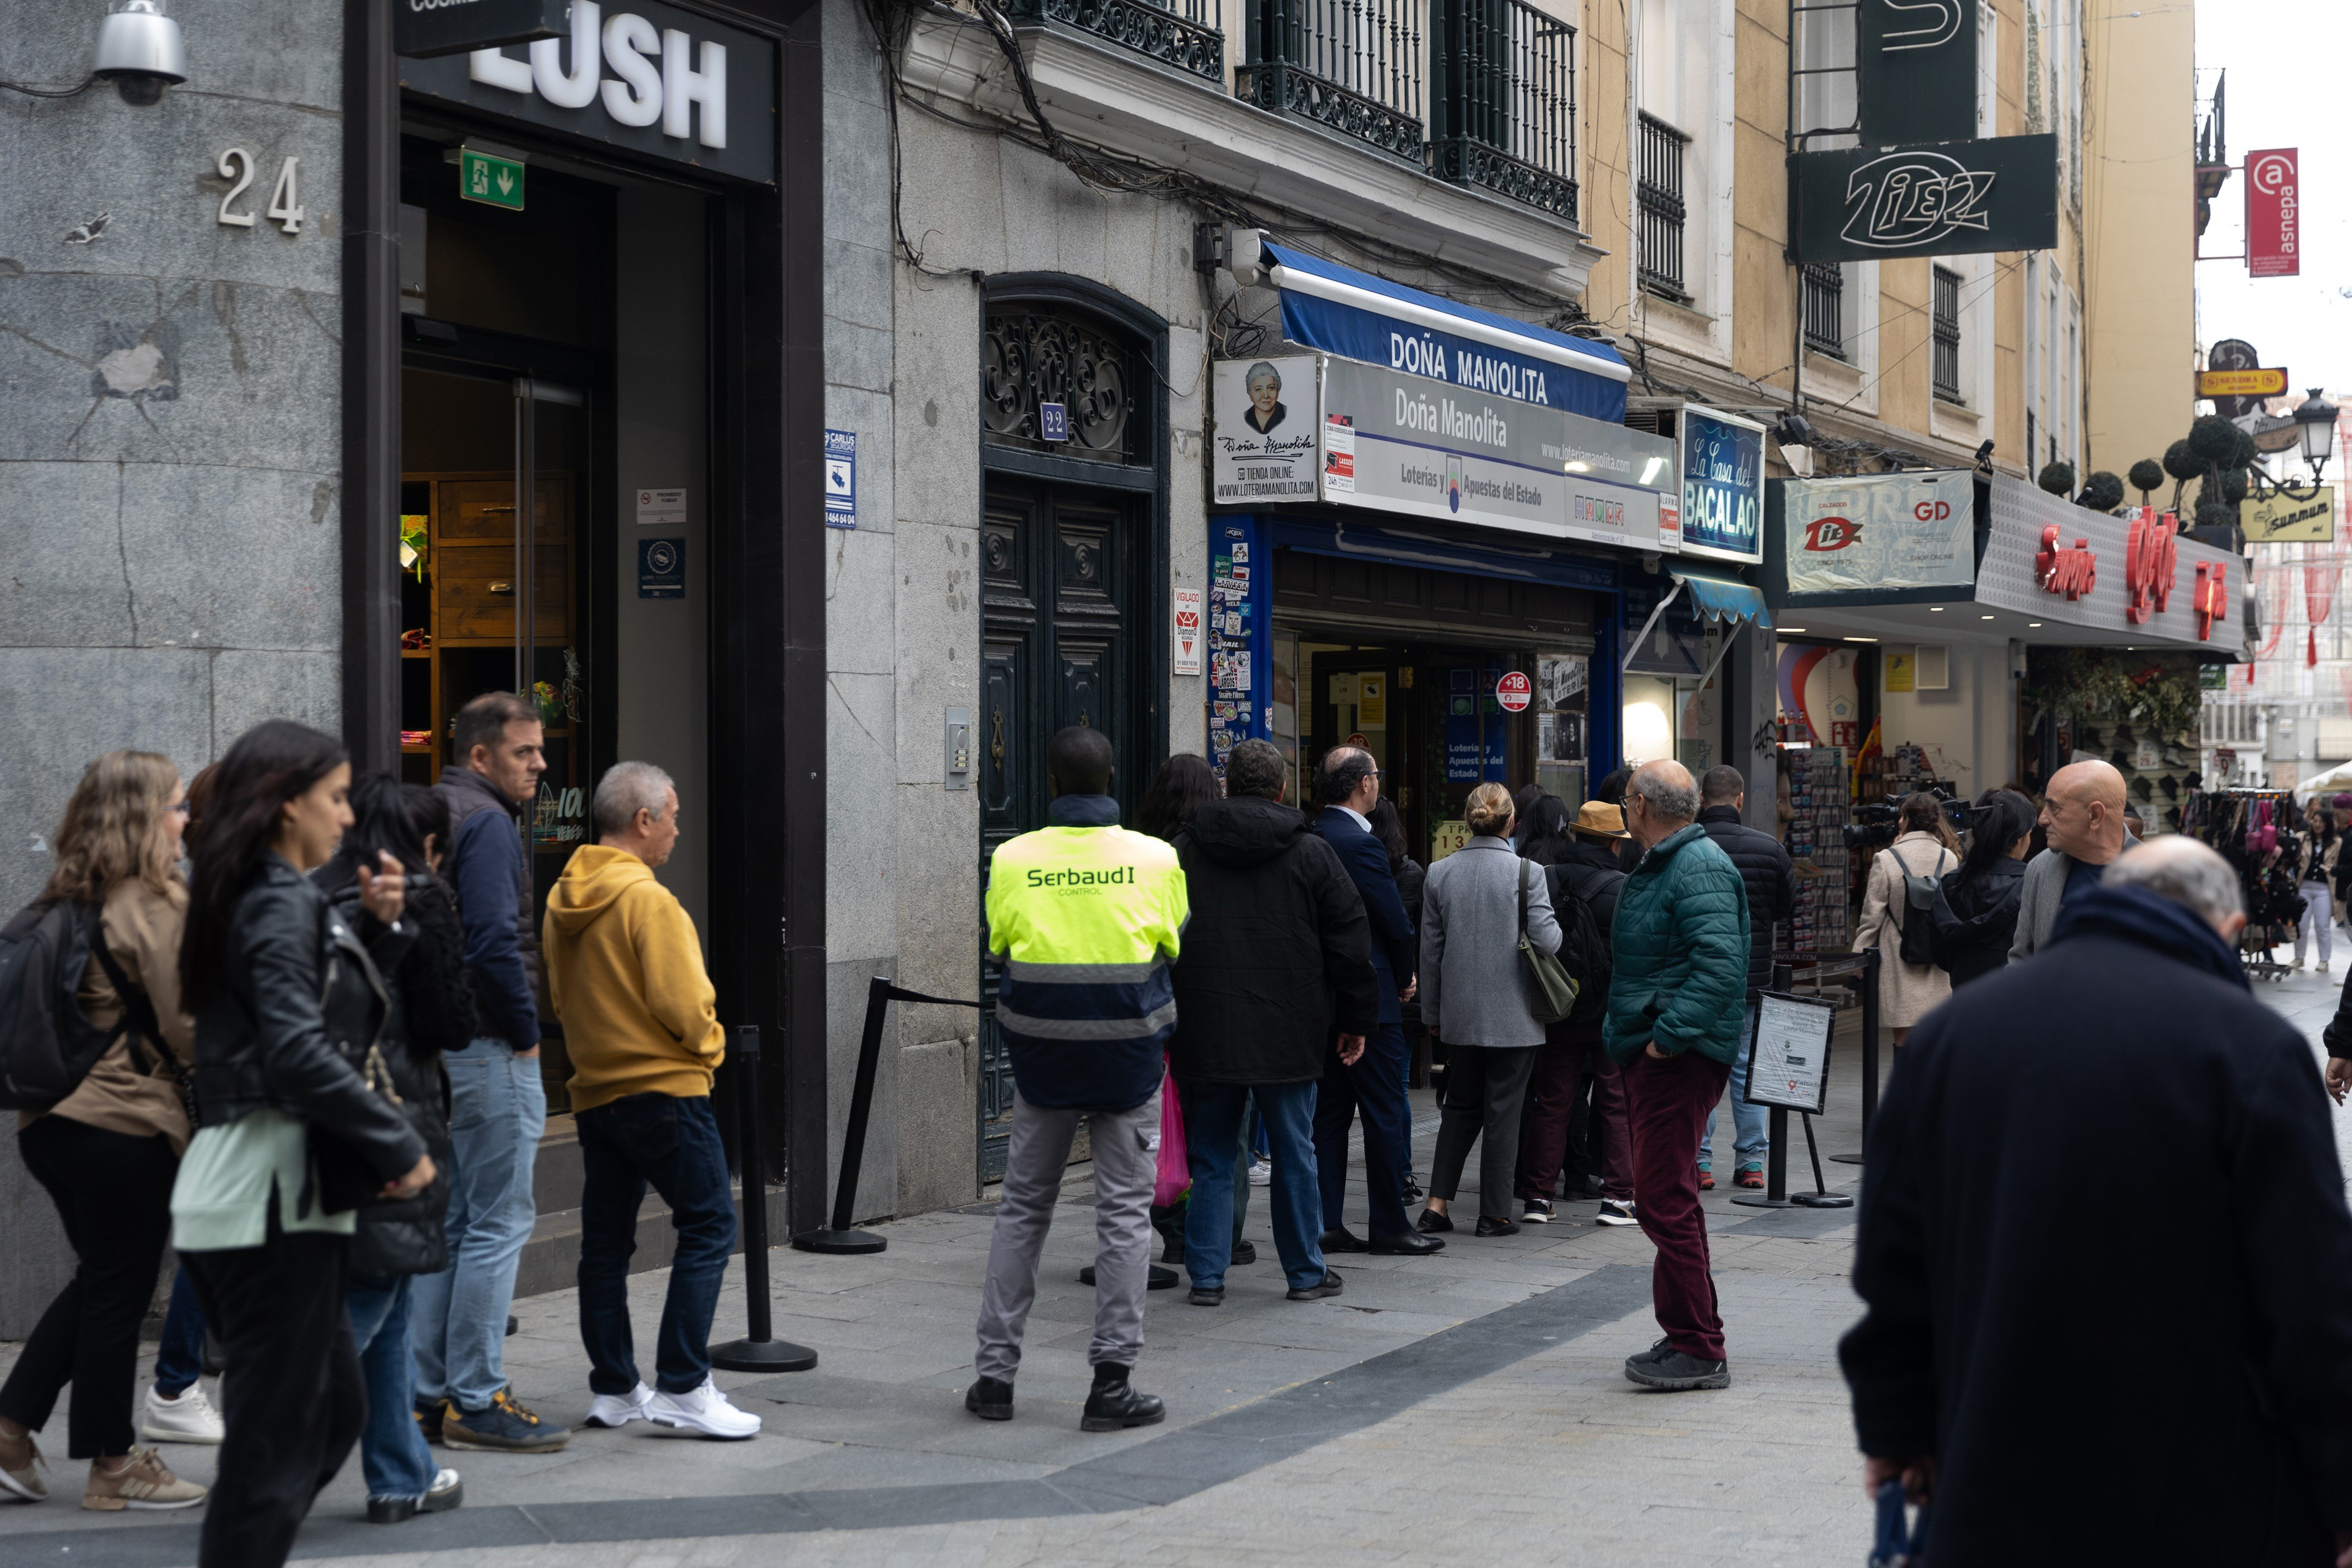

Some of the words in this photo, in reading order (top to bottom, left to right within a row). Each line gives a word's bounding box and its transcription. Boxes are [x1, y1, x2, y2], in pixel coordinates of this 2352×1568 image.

[217, 148, 305, 234] 24
[2280, 185, 2297, 254] asnepa
[1391, 332, 1447, 381] DOÑA
[1458, 350, 1548, 404] MANOLITA
[1045, 410, 1064, 434] 22
[1395, 388, 1437, 432] Doña
[1442, 399, 1507, 447] Manolita
[830, 432, 855, 445] CARLÚS
[1218, 437, 1260, 453] Doña
[829, 441, 854, 452] SEGURIDAD
[1339, 457, 1353, 466] LASSER
[1542, 443, 1630, 473] www.loteriamanolita.com
[1691, 437, 1706, 477] La
[1709, 441, 1732, 483] Casa
[1735, 452, 1753, 487] del
[1247, 467, 1268, 480] TIENDA
[1270, 466, 1294, 479] ONLINE:
[1329, 476, 1337, 486] 24h
[1401, 463, 1437, 488] Loterías
[1439, 473, 1444, 494] y
[1464, 474, 1501, 499] Apuestas
[1502, 481, 1514, 501] del
[1516, 484, 1542, 506] Estado
[1218, 481, 1314, 497] WWW.LOTERIAMANOLITA.COM
[1684, 481, 1757, 538] BACALAO
[1914, 500, 1951, 522] GD
[839, 513, 846, 524] 64
[847, 514, 855, 525] 04
[1176, 592, 1199, 603] VIGILADO
[1219, 677, 1235, 688] LARGOS
[1505, 676, 1525, 689] +18
[1238, 702, 1251, 711] LARGOS
[1485, 744, 1491, 753] y
[1449, 756, 1488, 766] Apuests
[1490, 756, 1503, 764] del
[1449, 769, 1478, 778] Estado
[1058, 888, 1102, 897] CONTROL
